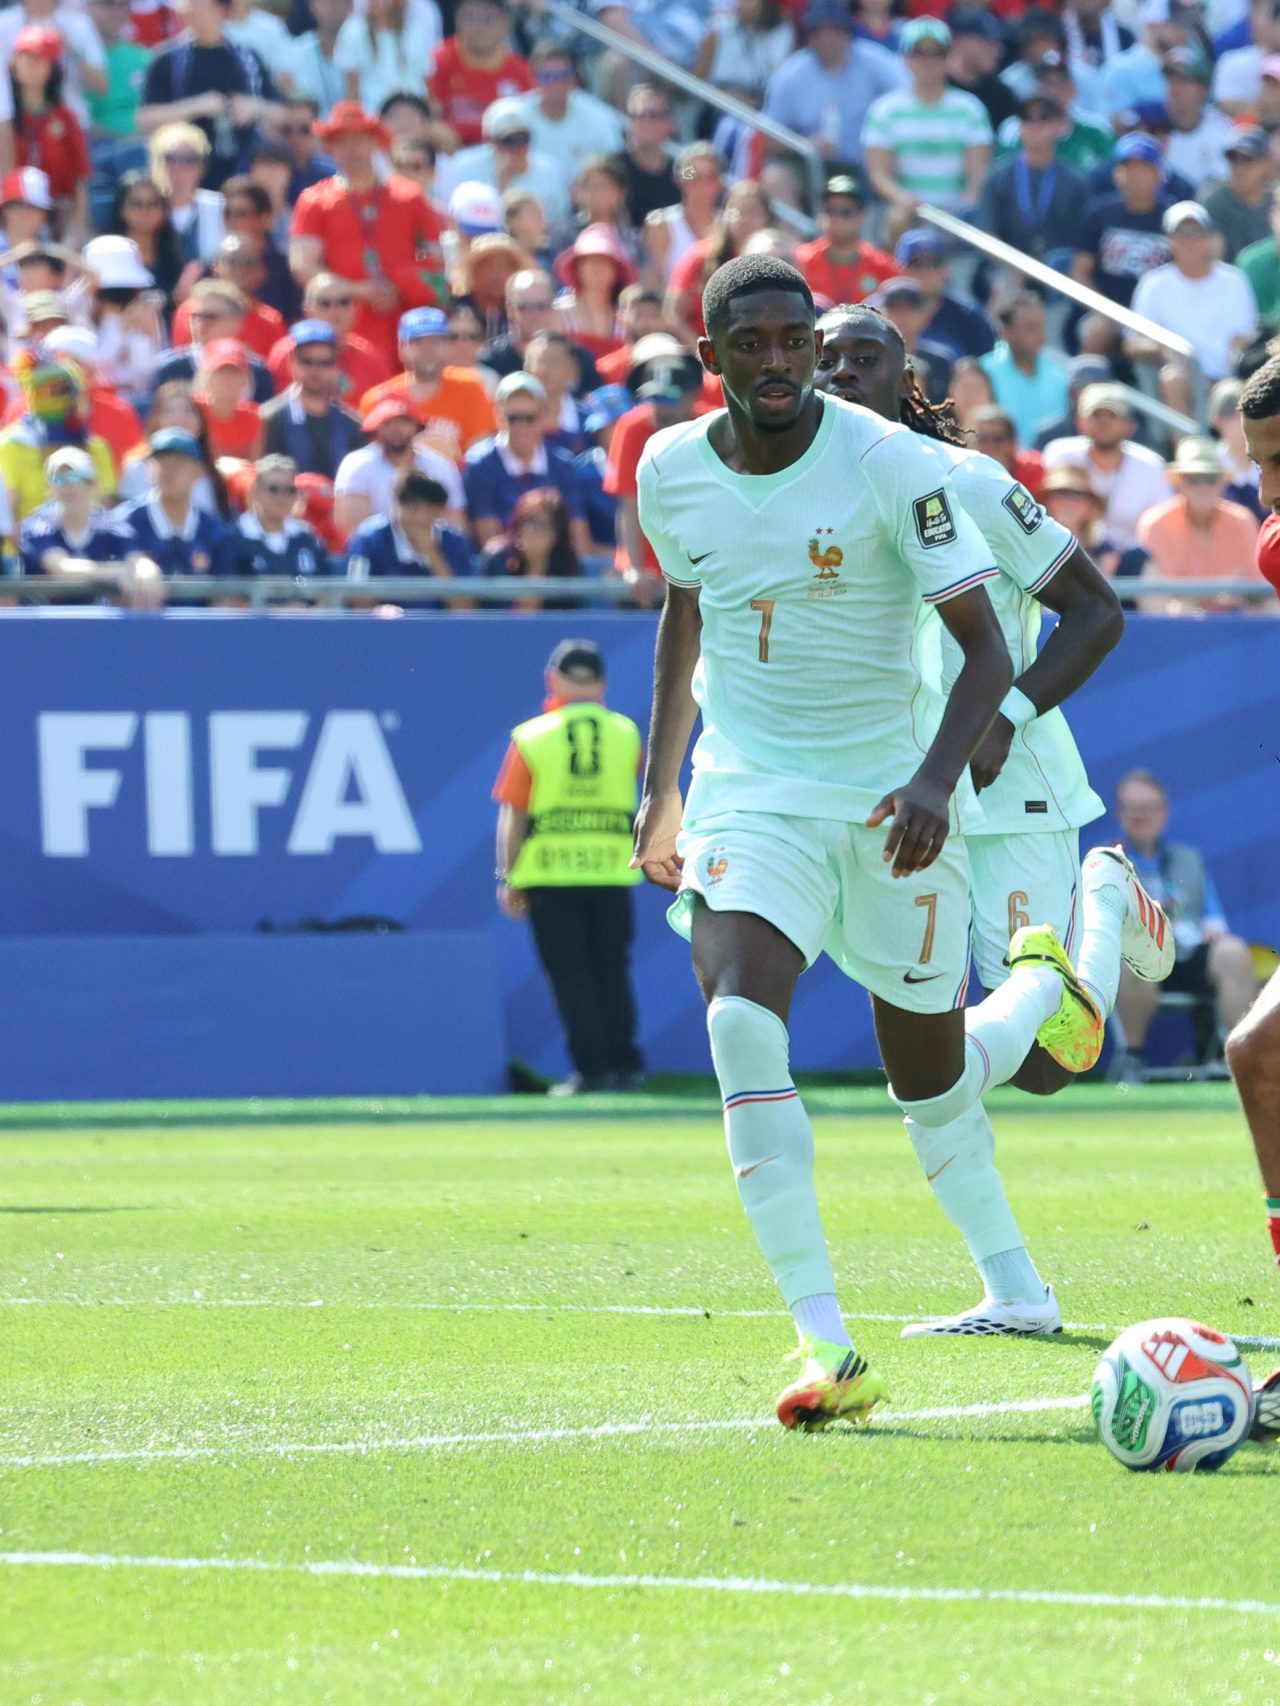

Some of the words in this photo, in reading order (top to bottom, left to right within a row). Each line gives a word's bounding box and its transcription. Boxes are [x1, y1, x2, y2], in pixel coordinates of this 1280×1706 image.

[750, 599, 776, 664] 7
[37, 710, 423, 857] FIFA
[915, 893, 937, 964] 7
[1008, 890, 1029, 941] 6
